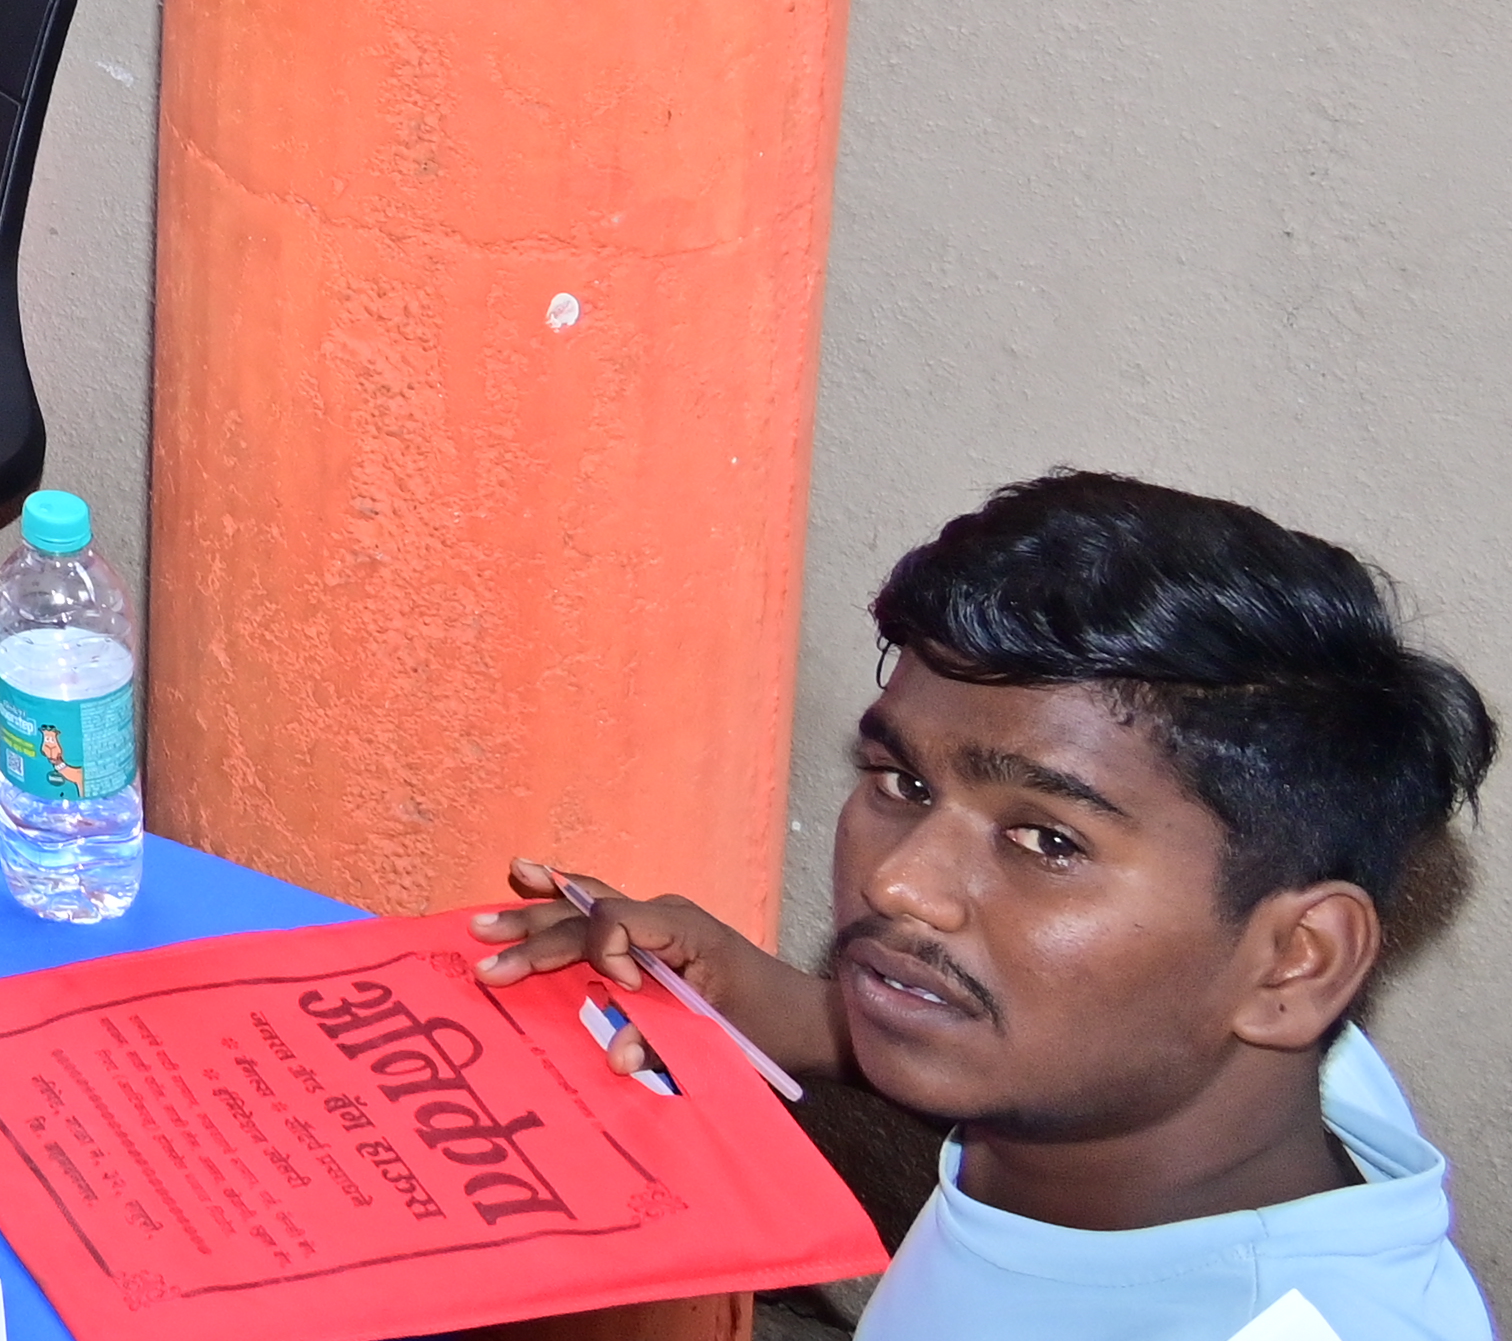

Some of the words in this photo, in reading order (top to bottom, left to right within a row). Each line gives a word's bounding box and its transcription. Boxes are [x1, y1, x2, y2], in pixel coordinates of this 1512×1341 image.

[250, 1011, 296, 1061] जनरल
[356, 1136, 446, 1221] हाऊस
[298, 980, 576, 1225] अनिकेत
